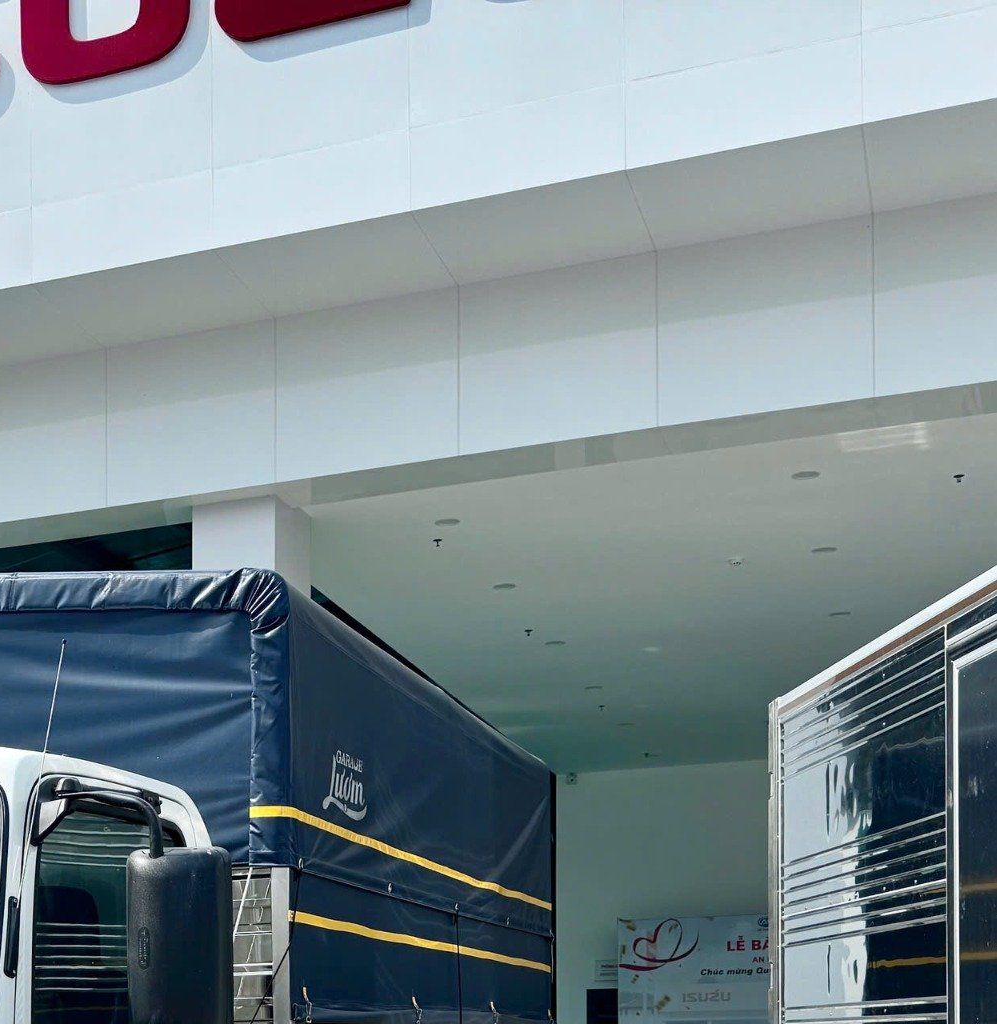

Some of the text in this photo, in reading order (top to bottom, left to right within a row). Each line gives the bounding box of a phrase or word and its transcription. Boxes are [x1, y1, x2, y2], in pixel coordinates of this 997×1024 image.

[336, 750, 363, 773] GARAGE
[726, 935, 745, 951] LỄ
[700, 967, 724, 976] Chúc
